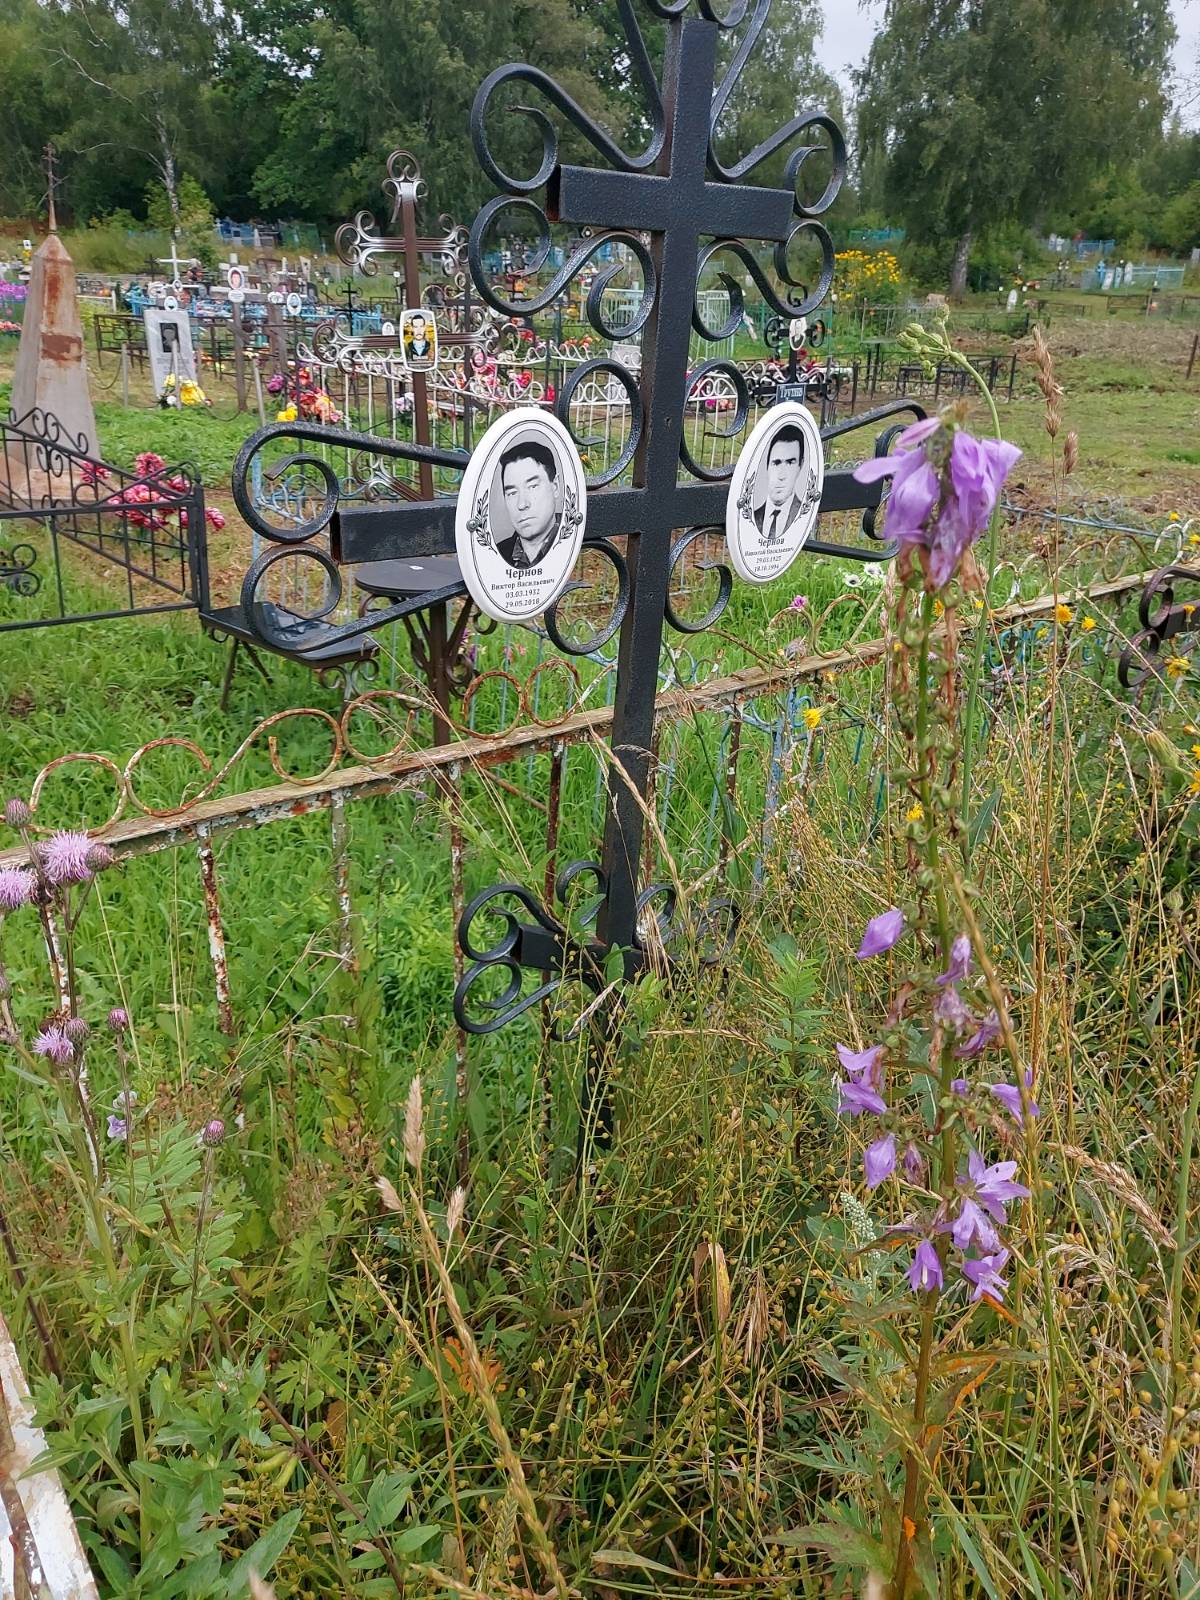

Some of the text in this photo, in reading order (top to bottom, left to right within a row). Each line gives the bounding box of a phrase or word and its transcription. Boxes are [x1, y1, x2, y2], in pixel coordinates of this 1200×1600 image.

[758, 538, 785, 548] Чернов
[505, 568, 543, 580] Чернов
[491, 578, 555, 591] Виктор Васильевич
